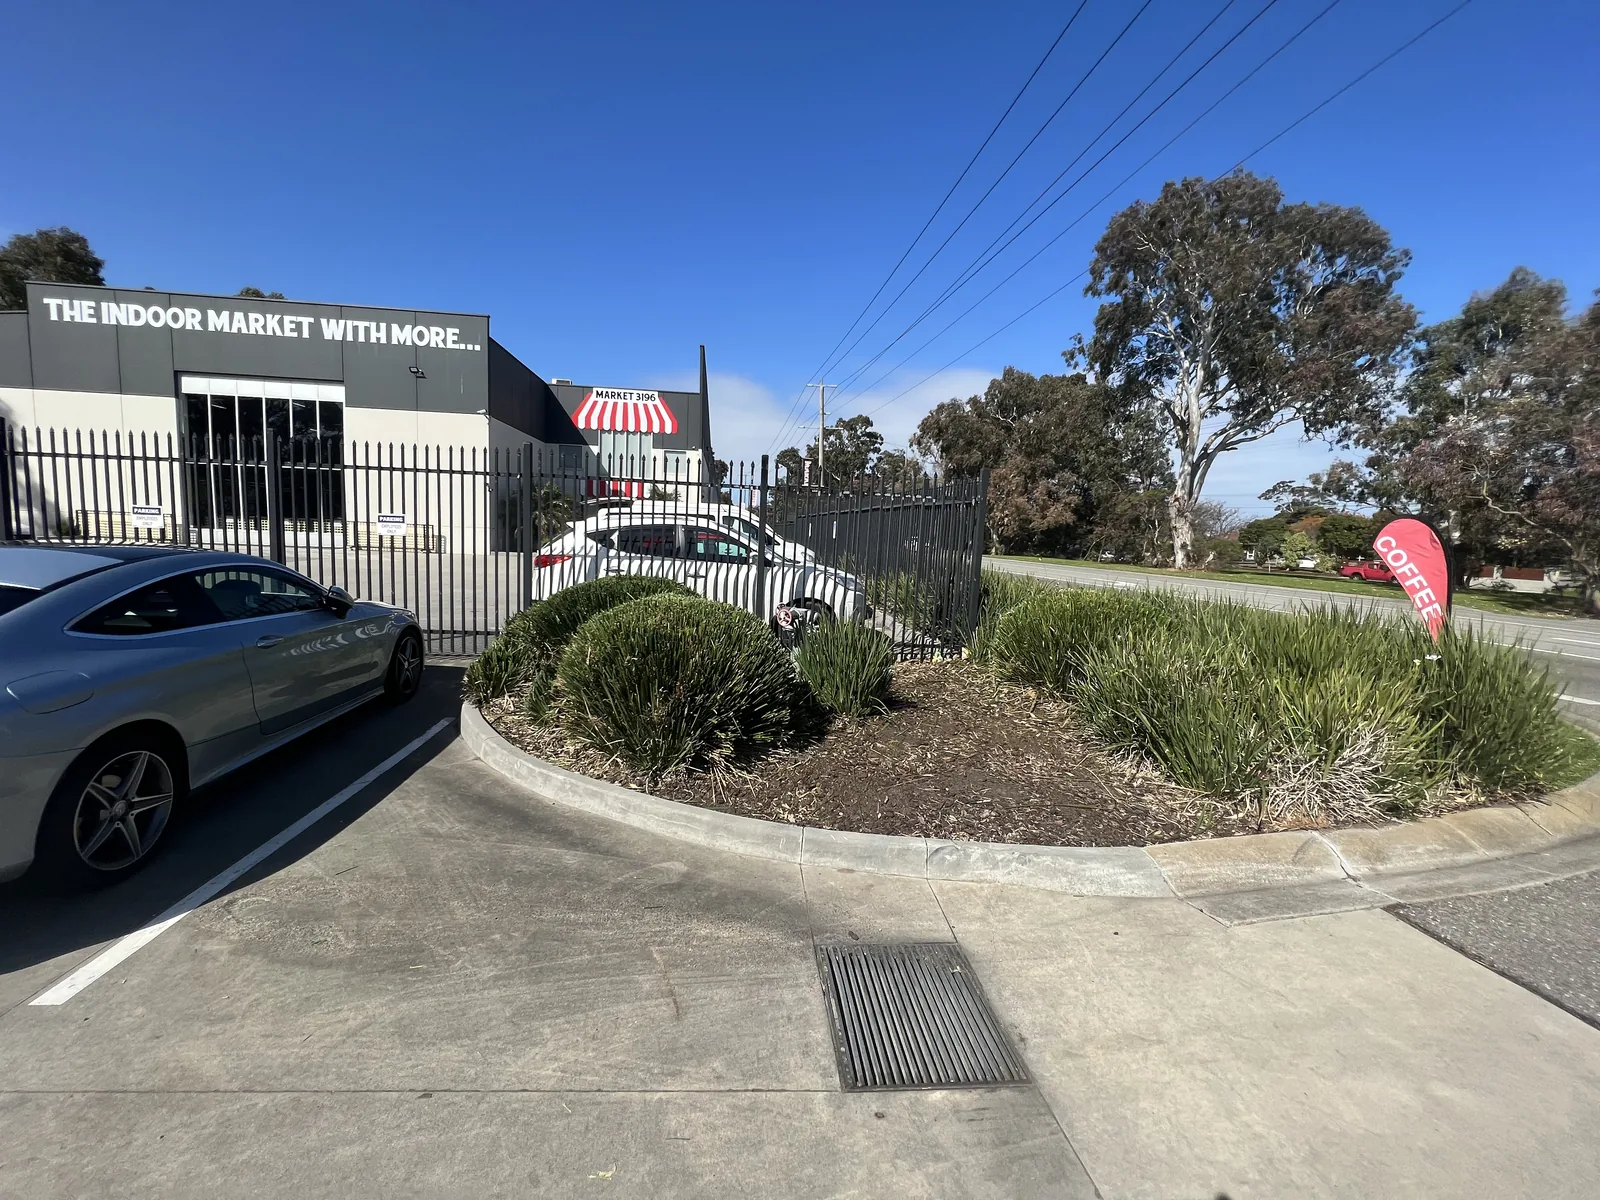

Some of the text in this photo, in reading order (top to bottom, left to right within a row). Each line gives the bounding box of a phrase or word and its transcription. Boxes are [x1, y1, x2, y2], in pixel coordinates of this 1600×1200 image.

[43, 298, 481, 351] THE INDOOR MARKET WITH MORE...
[595, 390, 656, 402] MARKET 3196
[1376, 536, 1442, 621] COFFEE
